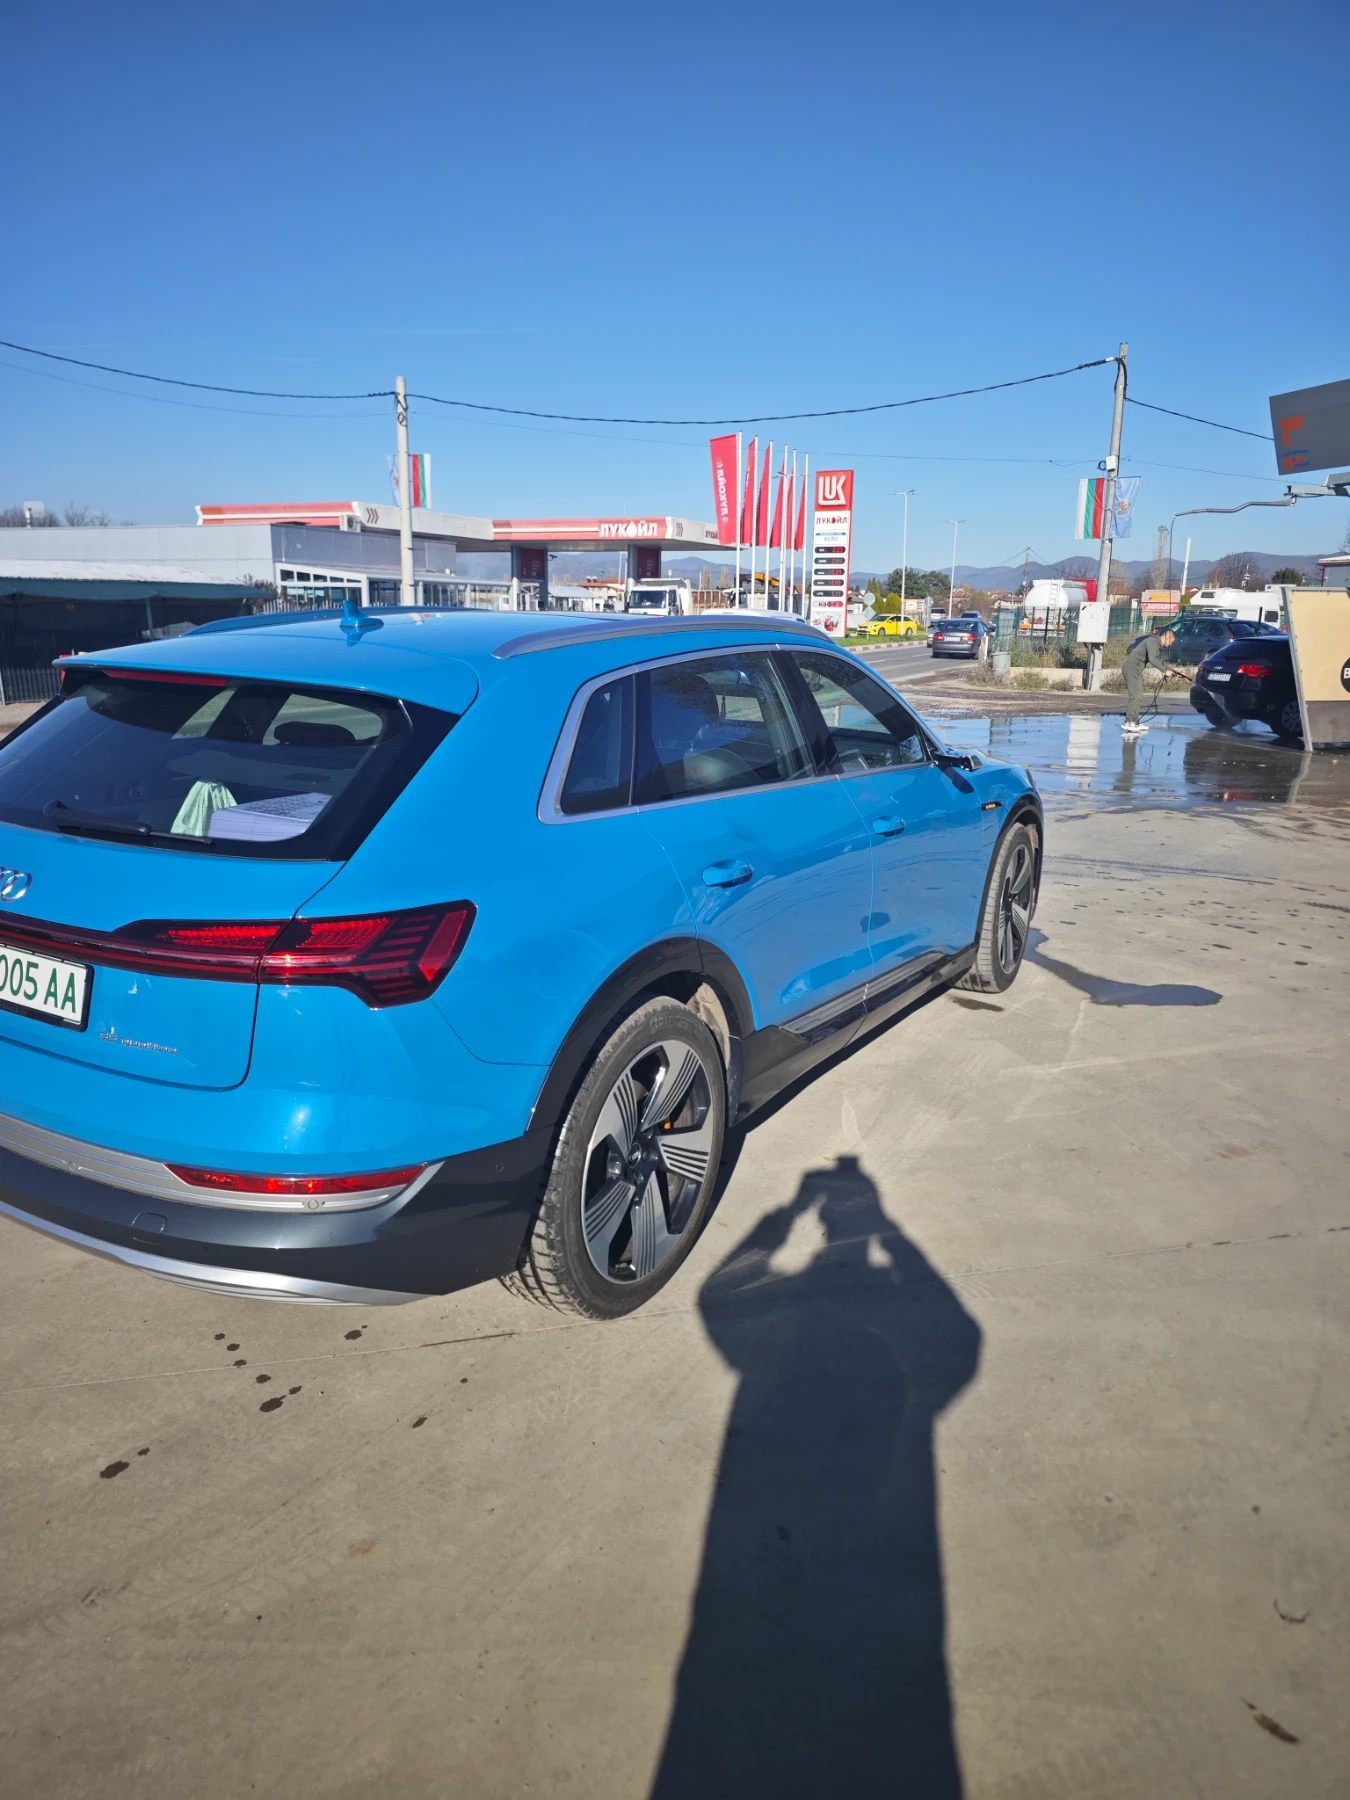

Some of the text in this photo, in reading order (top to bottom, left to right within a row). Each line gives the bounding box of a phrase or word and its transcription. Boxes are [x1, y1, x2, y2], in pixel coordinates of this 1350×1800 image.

[818, 475, 846, 506] LUK
[599, 520, 658, 537] ЛУКОЙЛ
[43, 967, 77, 1014] AA
